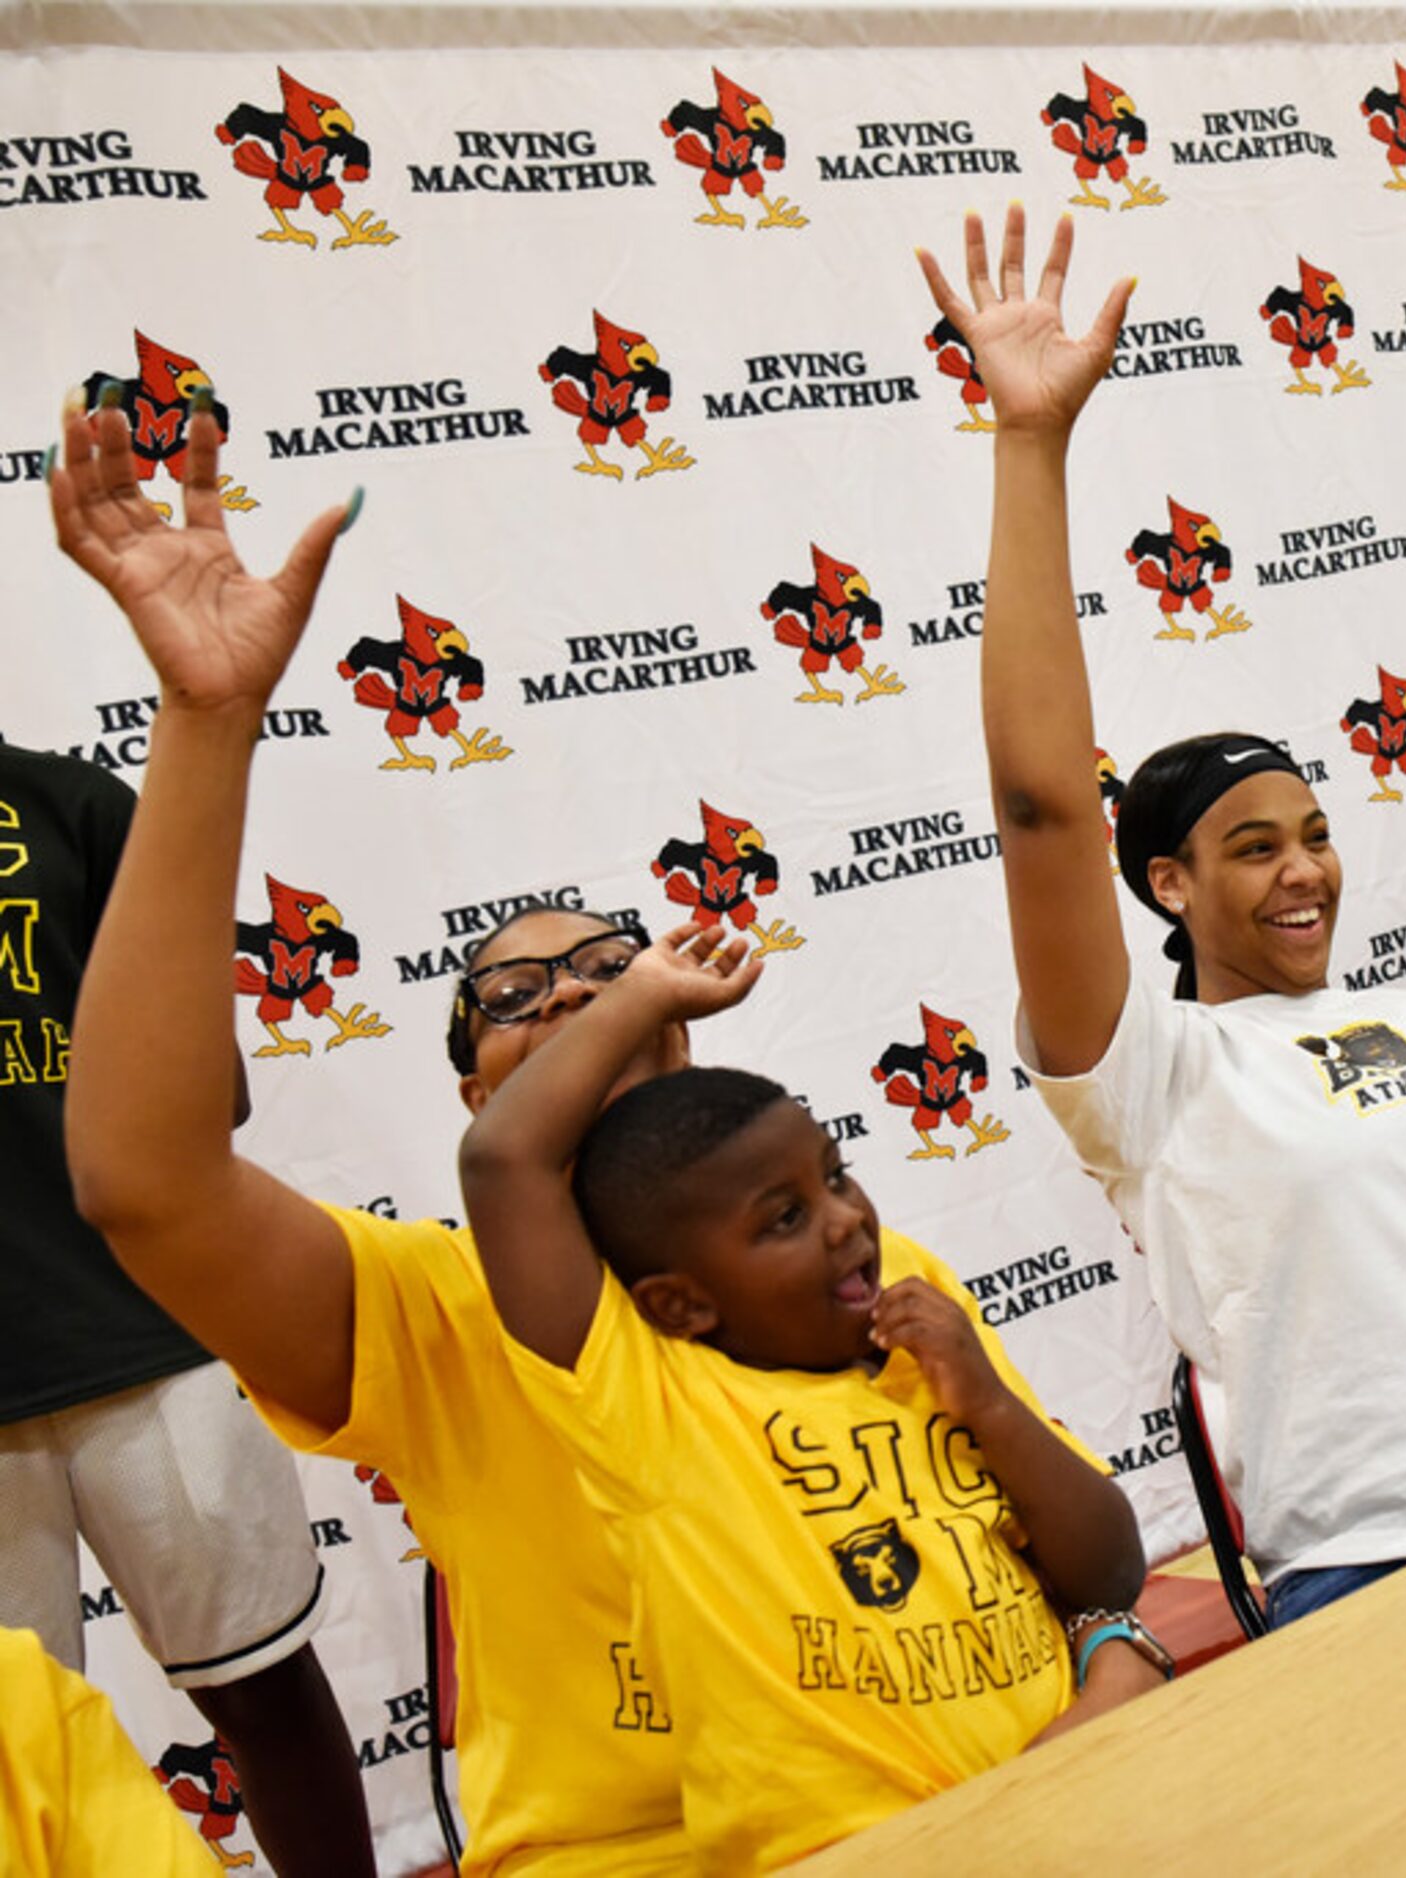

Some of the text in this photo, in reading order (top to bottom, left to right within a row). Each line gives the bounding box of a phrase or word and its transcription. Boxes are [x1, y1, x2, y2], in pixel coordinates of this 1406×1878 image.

[857, 120, 974, 149] IRVING
[1204, 105, 1299, 136] IRVING
[0, 130, 132, 169] RVING
[456, 131, 595, 159] IRVING
[1171, 132, 1337, 165] MACARTHUR
[410, 160, 655, 193] MACARTHUR
[817, 149, 1021, 181] MACARTHUR
[0, 167, 209, 207] CARTHUR
[1115, 317, 1205, 349] RVING
[746, 352, 867, 383] IRVING
[1103, 344, 1242, 380] CARTHUR
[317, 379, 466, 418] IRVING
[703, 376, 920, 420] MACARTHUR
[266, 409, 530, 459] MACARTHUR
[1281, 517, 1376, 555] IRVING
[567, 625, 698, 664] IRVING
[521, 648, 757, 704] MACARTHUR
[850, 811, 964, 856] IRVING
[963, 1246, 1071, 1301] IRVING
[981, 1260, 1119, 1327] CARTHUR
[764, 1411, 1004, 1518] SIC
